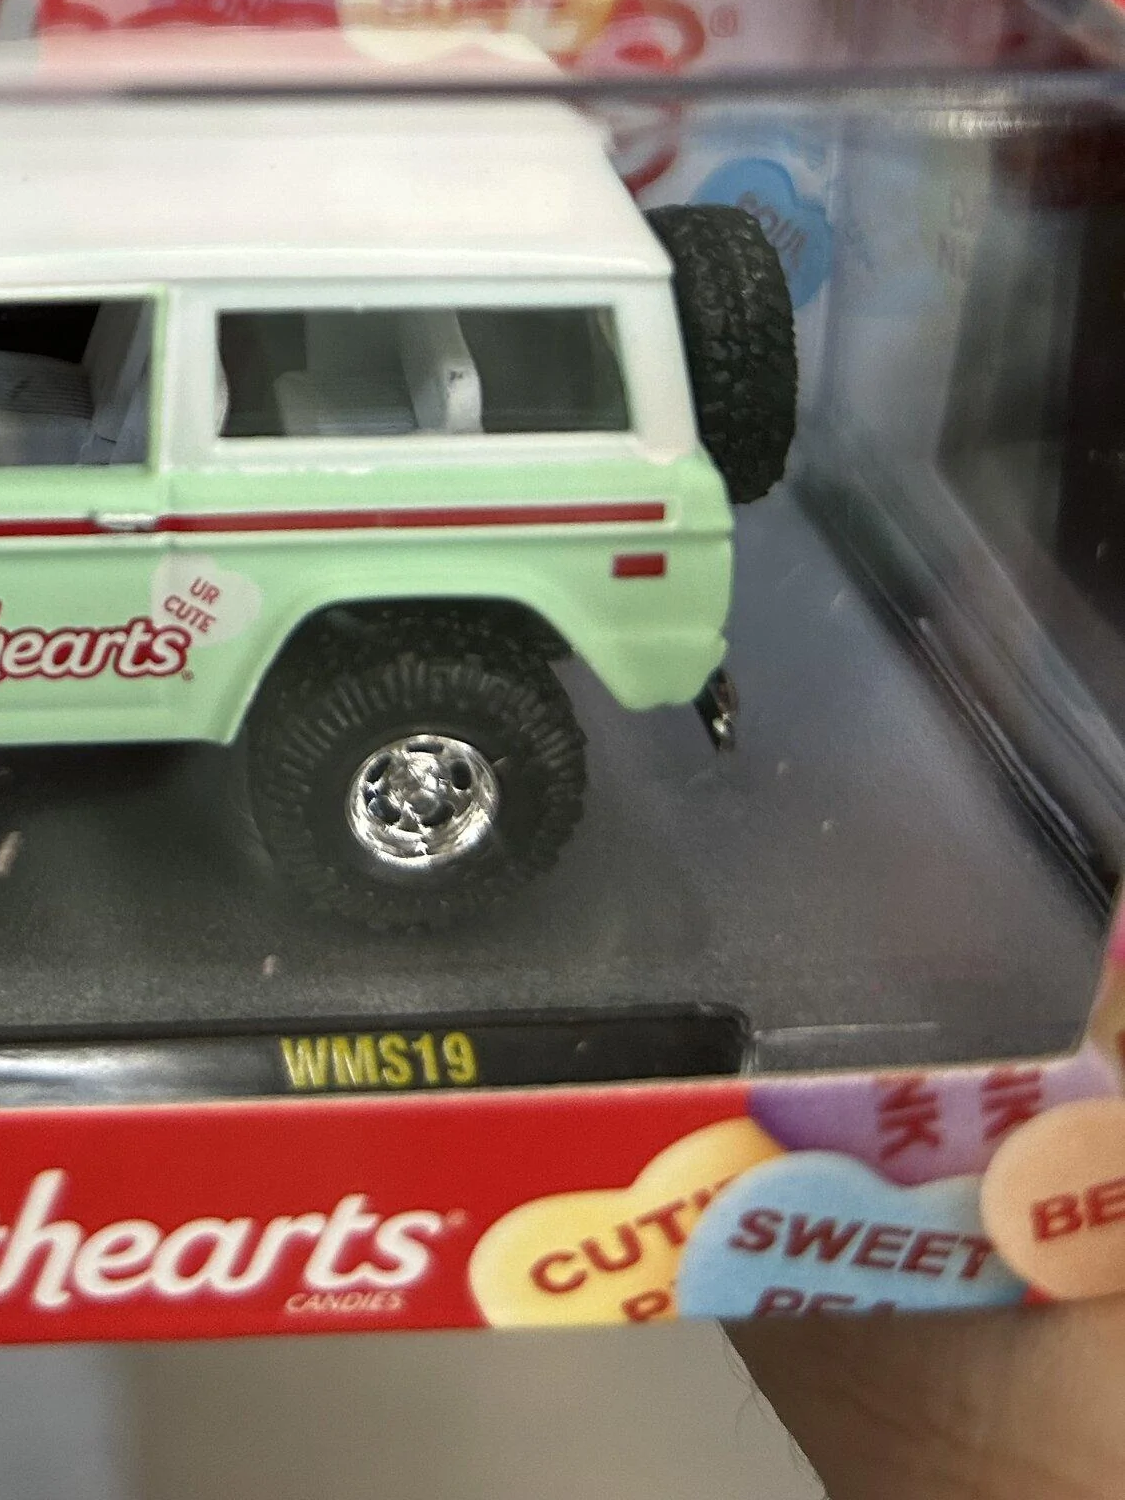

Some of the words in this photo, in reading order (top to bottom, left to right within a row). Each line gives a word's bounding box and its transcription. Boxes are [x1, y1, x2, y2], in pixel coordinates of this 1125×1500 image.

[188, 574, 222, 606] UR
[162, 593, 216, 633] CUTE
[280, 1031, 476, 1088] WMS19
[728, 1205, 999, 1281] SWEET
[285, 1290, 403, 1313] CANDIES
